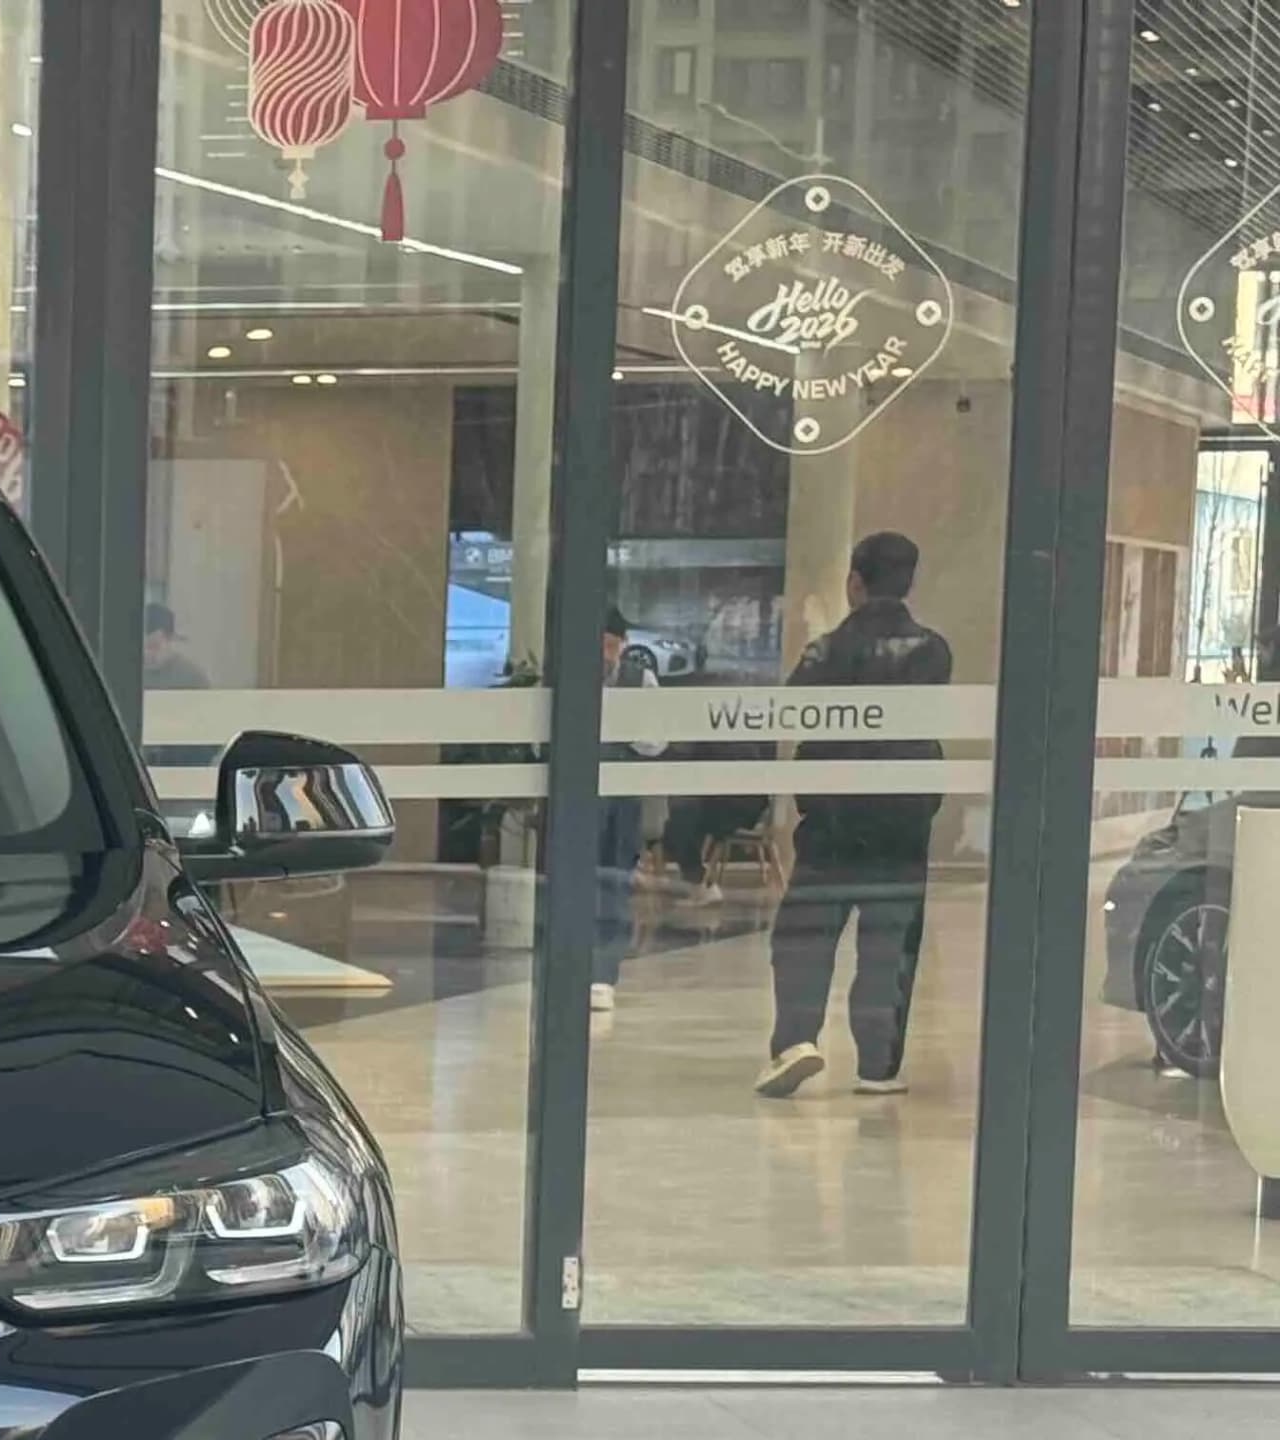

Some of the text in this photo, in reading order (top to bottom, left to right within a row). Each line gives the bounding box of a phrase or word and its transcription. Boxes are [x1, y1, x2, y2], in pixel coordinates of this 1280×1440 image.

[822, 231, 905, 281] 开新出发
[746, 276, 849, 333] Hello
[717, 335, 908, 399] HAPPY NEW YEAR
[707, 698, 884, 731] Welcome
